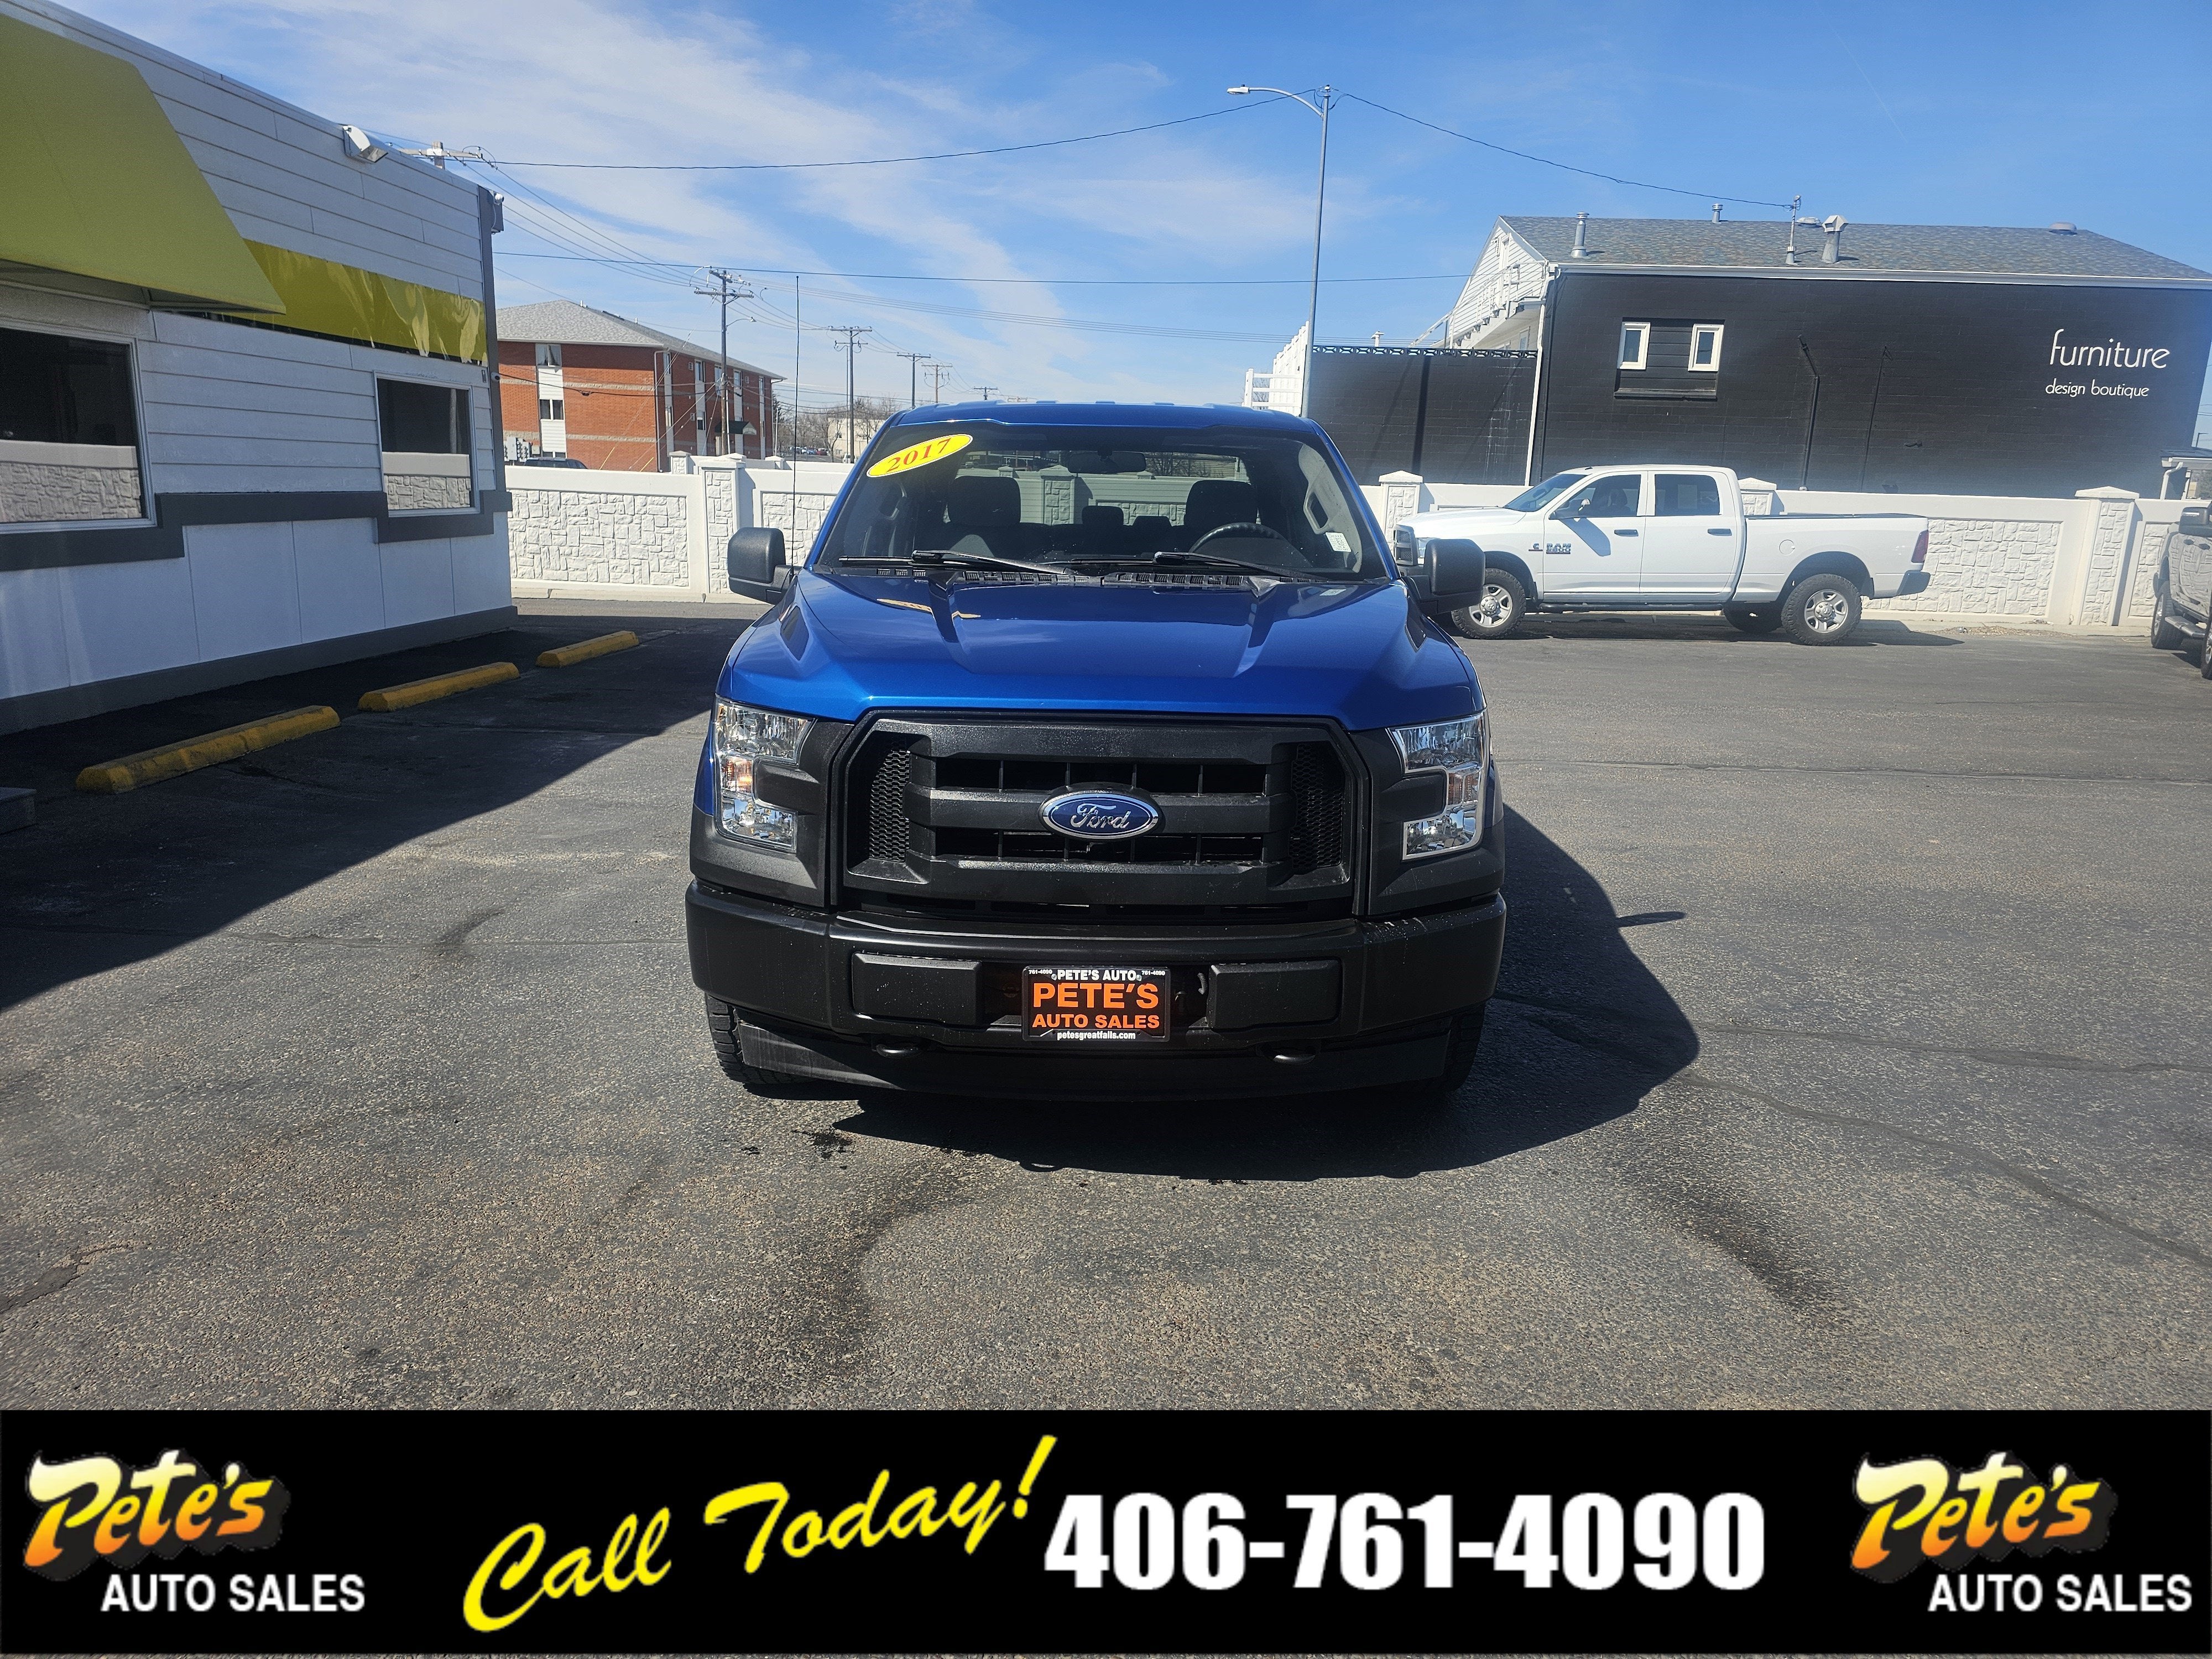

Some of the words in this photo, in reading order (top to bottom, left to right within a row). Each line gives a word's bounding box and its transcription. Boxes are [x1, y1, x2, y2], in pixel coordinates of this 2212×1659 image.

[2049, 328, 2170, 369] furniture
[2045, 378, 2085, 398] design
[2091, 379, 2150, 399] boutique
[886, 437, 951, 473] 2017
[1070, 803, 1132, 829] Ford
[1057, 969, 1099, 980] PETE'S
[1102, 969, 1136, 981] AUTO
[1033, 983, 1159, 1009] PETE'S
[1032, 1014, 1088, 1028] AUTO
[1094, 1015, 1160, 1029] SALES
[1057, 1030, 1136, 1040] petesgreatfalls.com
